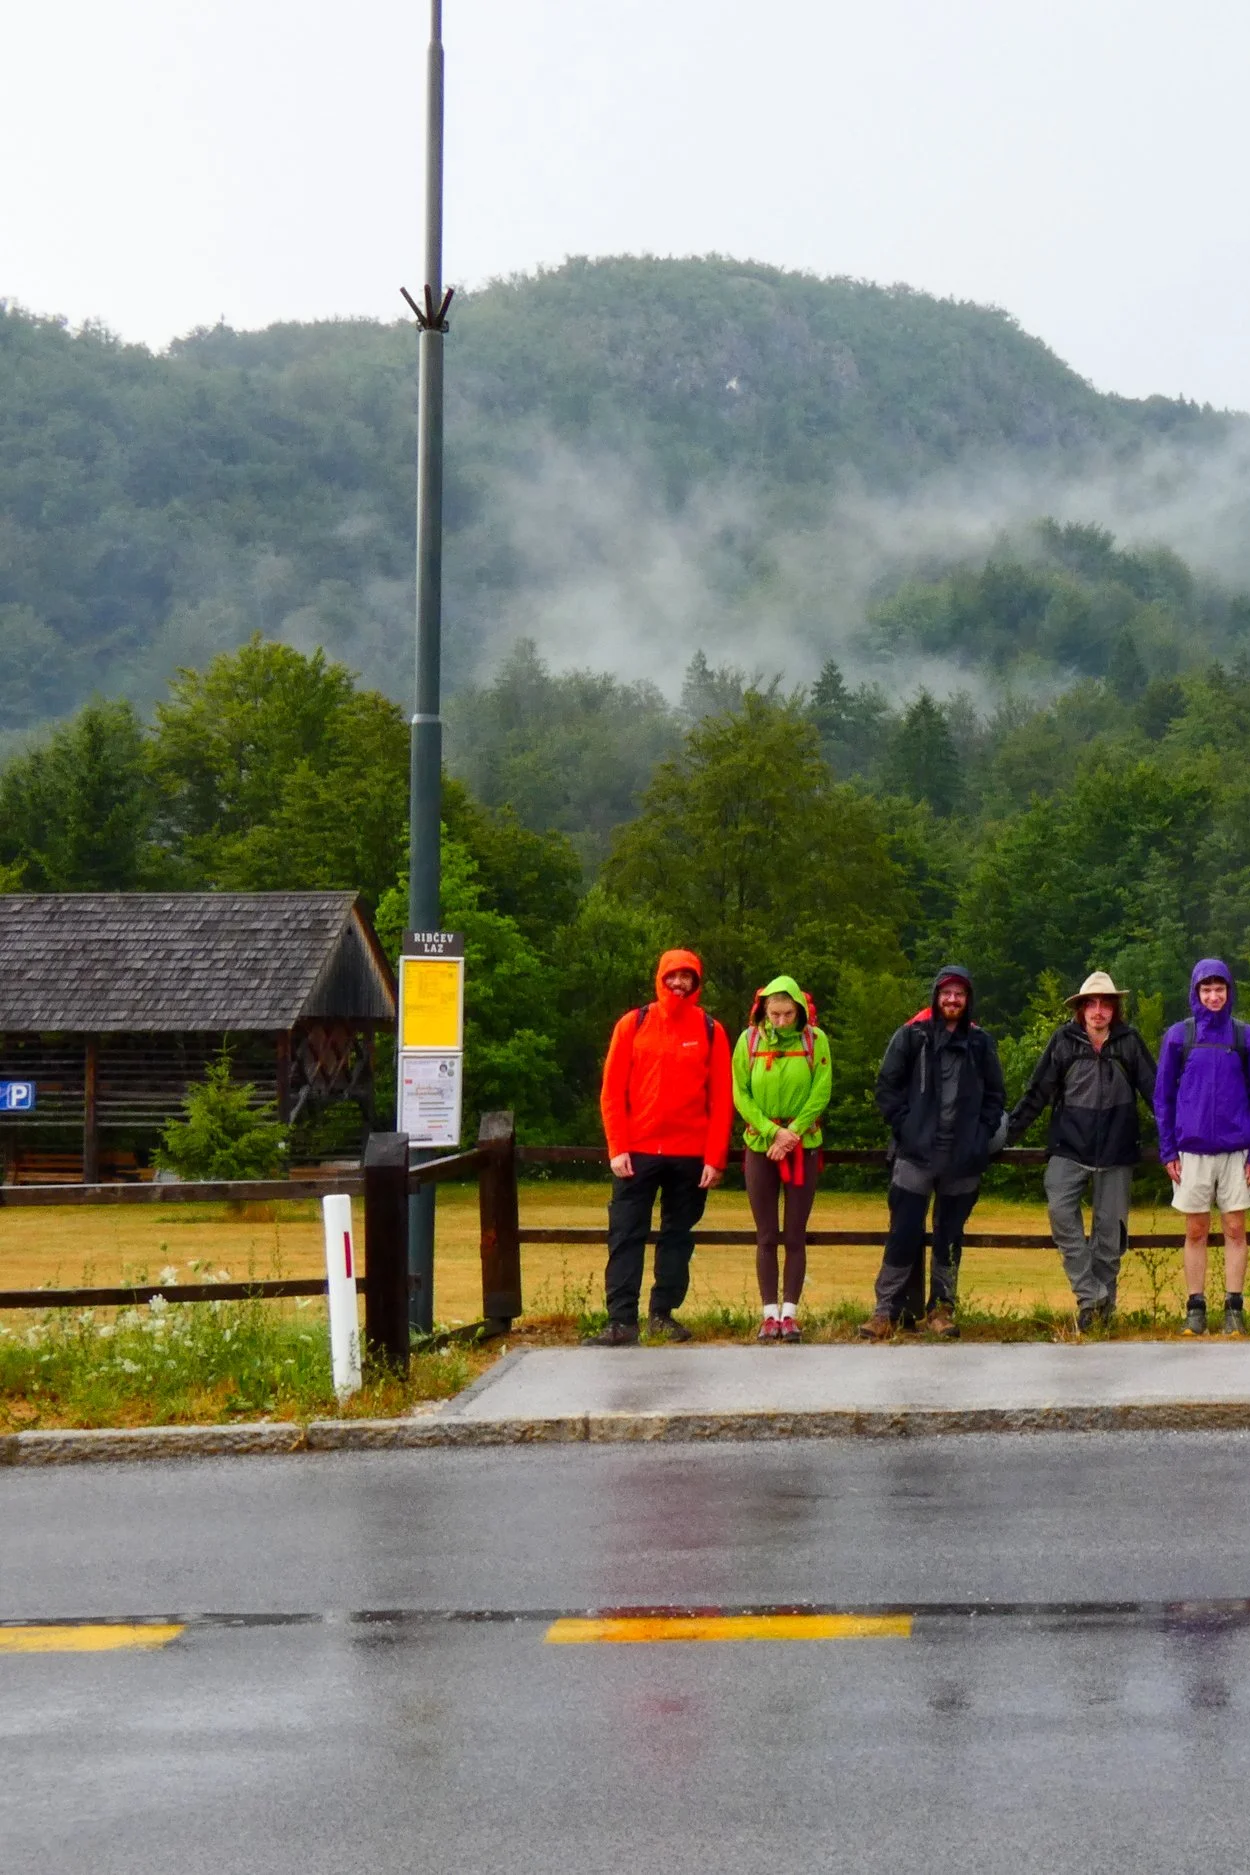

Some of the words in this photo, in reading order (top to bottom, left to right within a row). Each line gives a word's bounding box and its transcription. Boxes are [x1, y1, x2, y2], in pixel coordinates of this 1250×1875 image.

[413, 932, 454, 943] RIBČEV
[424, 944, 444, 953] LAZ
[11, 1085, 27, 1107] P
